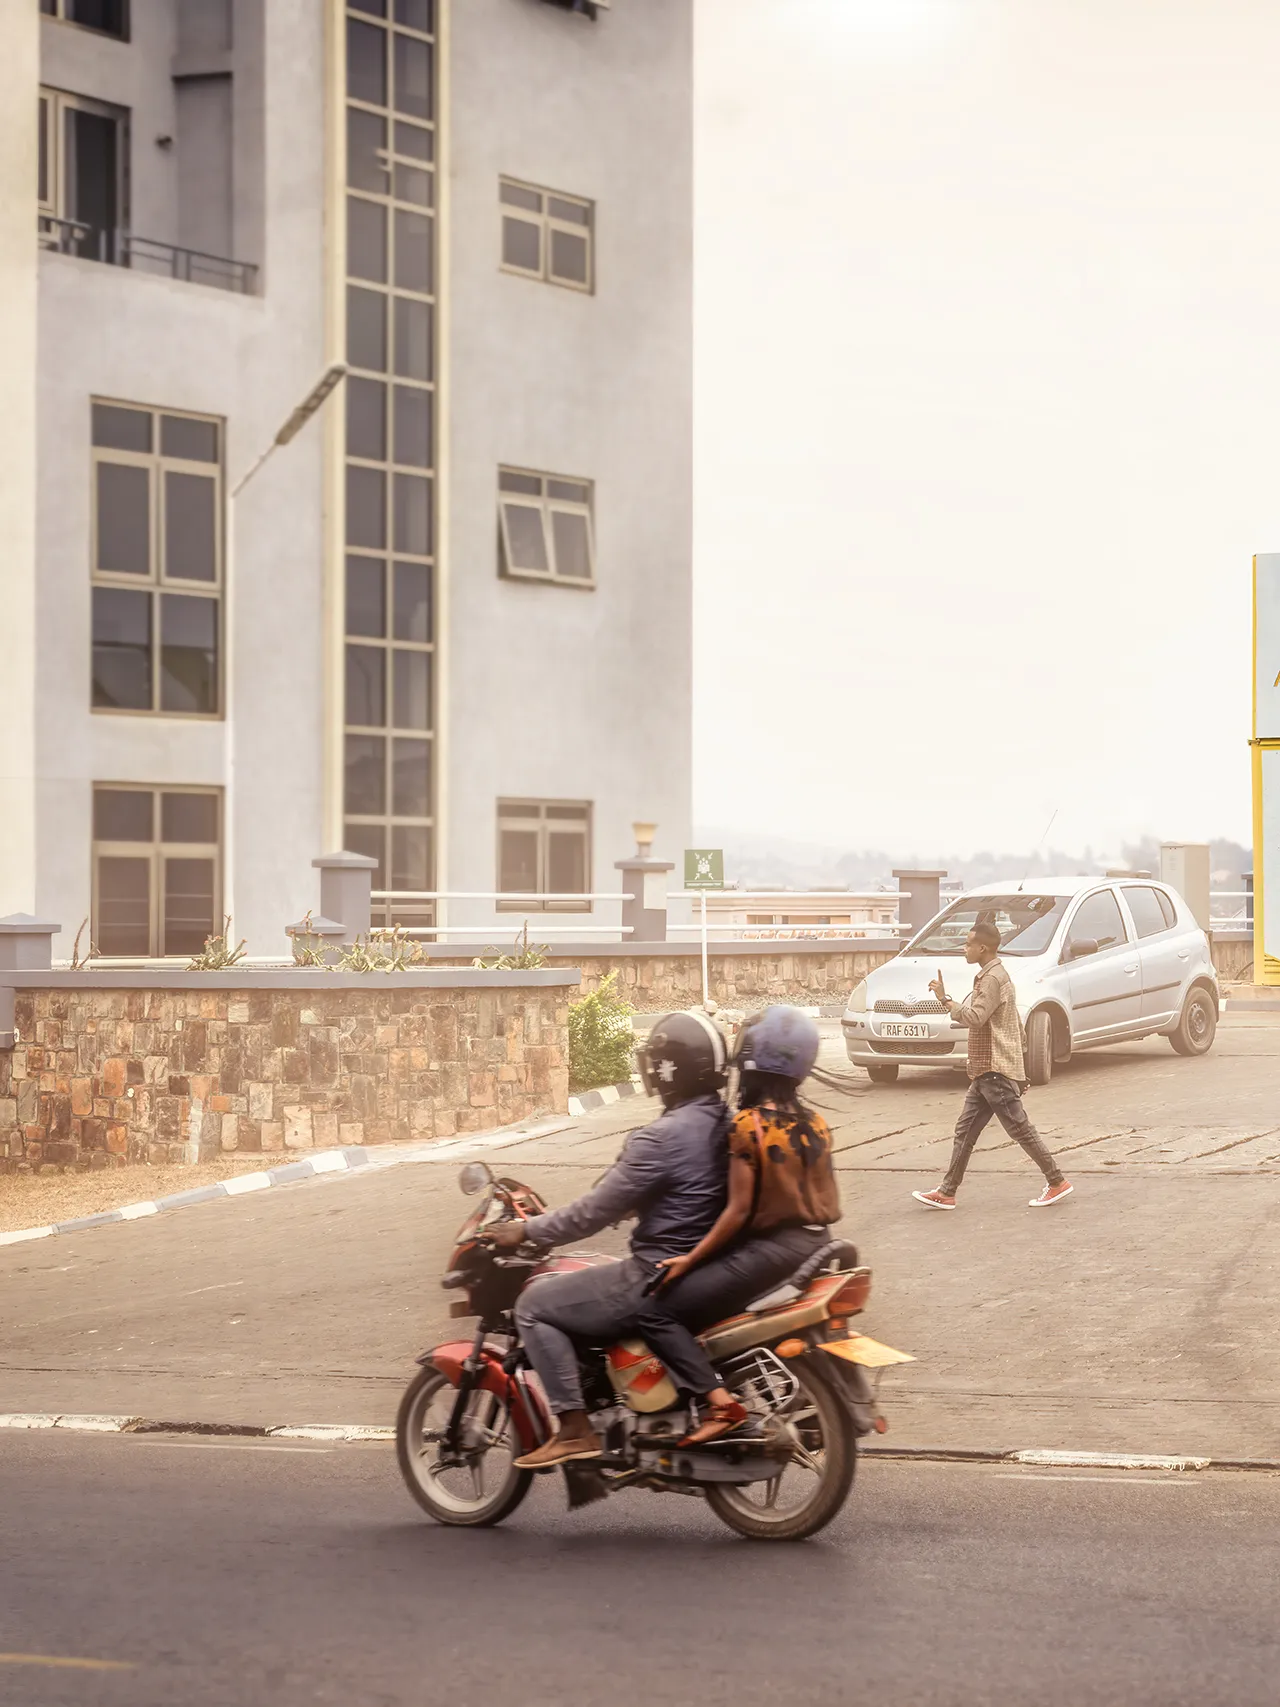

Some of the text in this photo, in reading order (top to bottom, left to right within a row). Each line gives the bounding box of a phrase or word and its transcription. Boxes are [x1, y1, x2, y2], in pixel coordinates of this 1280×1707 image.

[886, 1025, 926, 1037] RAF 631 Y
